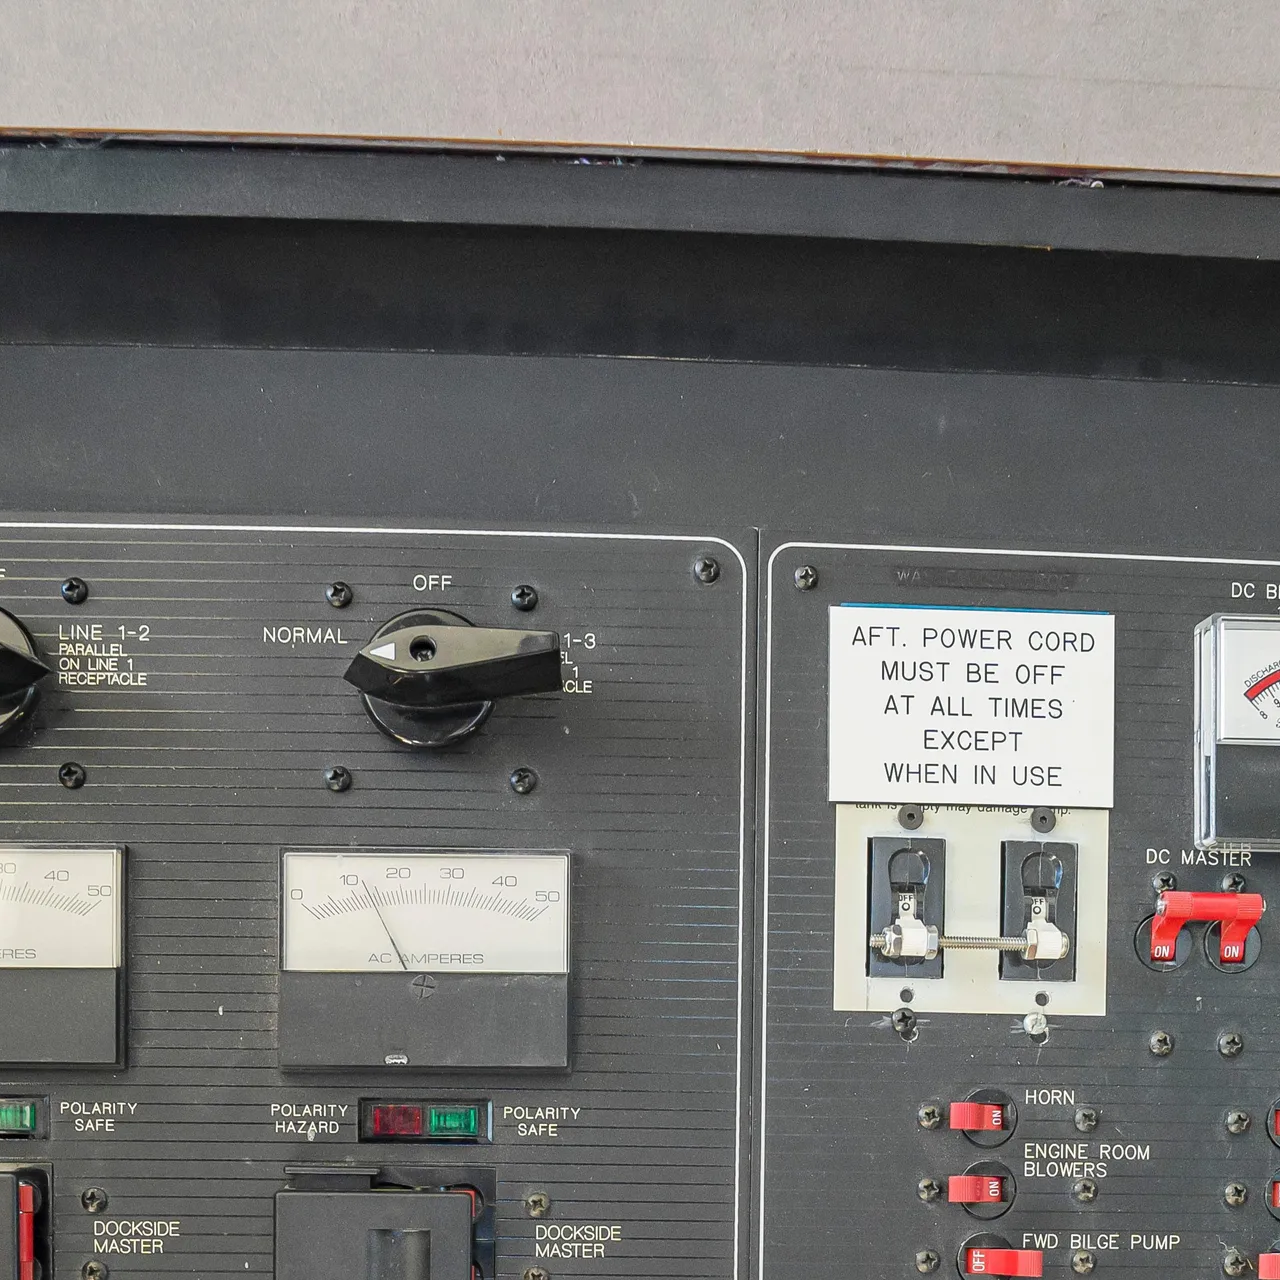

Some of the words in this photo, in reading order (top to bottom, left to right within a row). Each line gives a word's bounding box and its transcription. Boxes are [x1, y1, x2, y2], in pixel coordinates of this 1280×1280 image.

[1231, 581, 1255, 599] DC
[263, 626, 348, 644] NORMAL
[851, 625, 906, 648] AFT.
[923, 627, 1013, 651] POWER
[1028, 630, 1095, 653] CORD
[58, 642, 129, 657] PARALLEL
[59, 657, 80, 671] ON
[87, 657, 119, 671] LINE
[127, 658, 133, 671] 1
[881, 660, 951, 682] MUST
[966, 662, 1000, 684] BE
[1015, 663, 1066, 686] OFF
[58, 671, 148, 686] RECEPTACLE
[883, 694, 915, 715] AT
[930, 695, 973, 717] ALL
[988, 697, 1063, 720] TIMES
[923, 729, 1023, 752] EXCEPT
[883, 762, 957, 784] WHEN
[974, 764, 996, 785] IN
[1012, 765, 1063, 787] USE
[1025, 1089, 1075, 1106] HORN
[60, 1101, 138, 1115] POLARITY
[74, 1118, 115, 1132] SAFE
